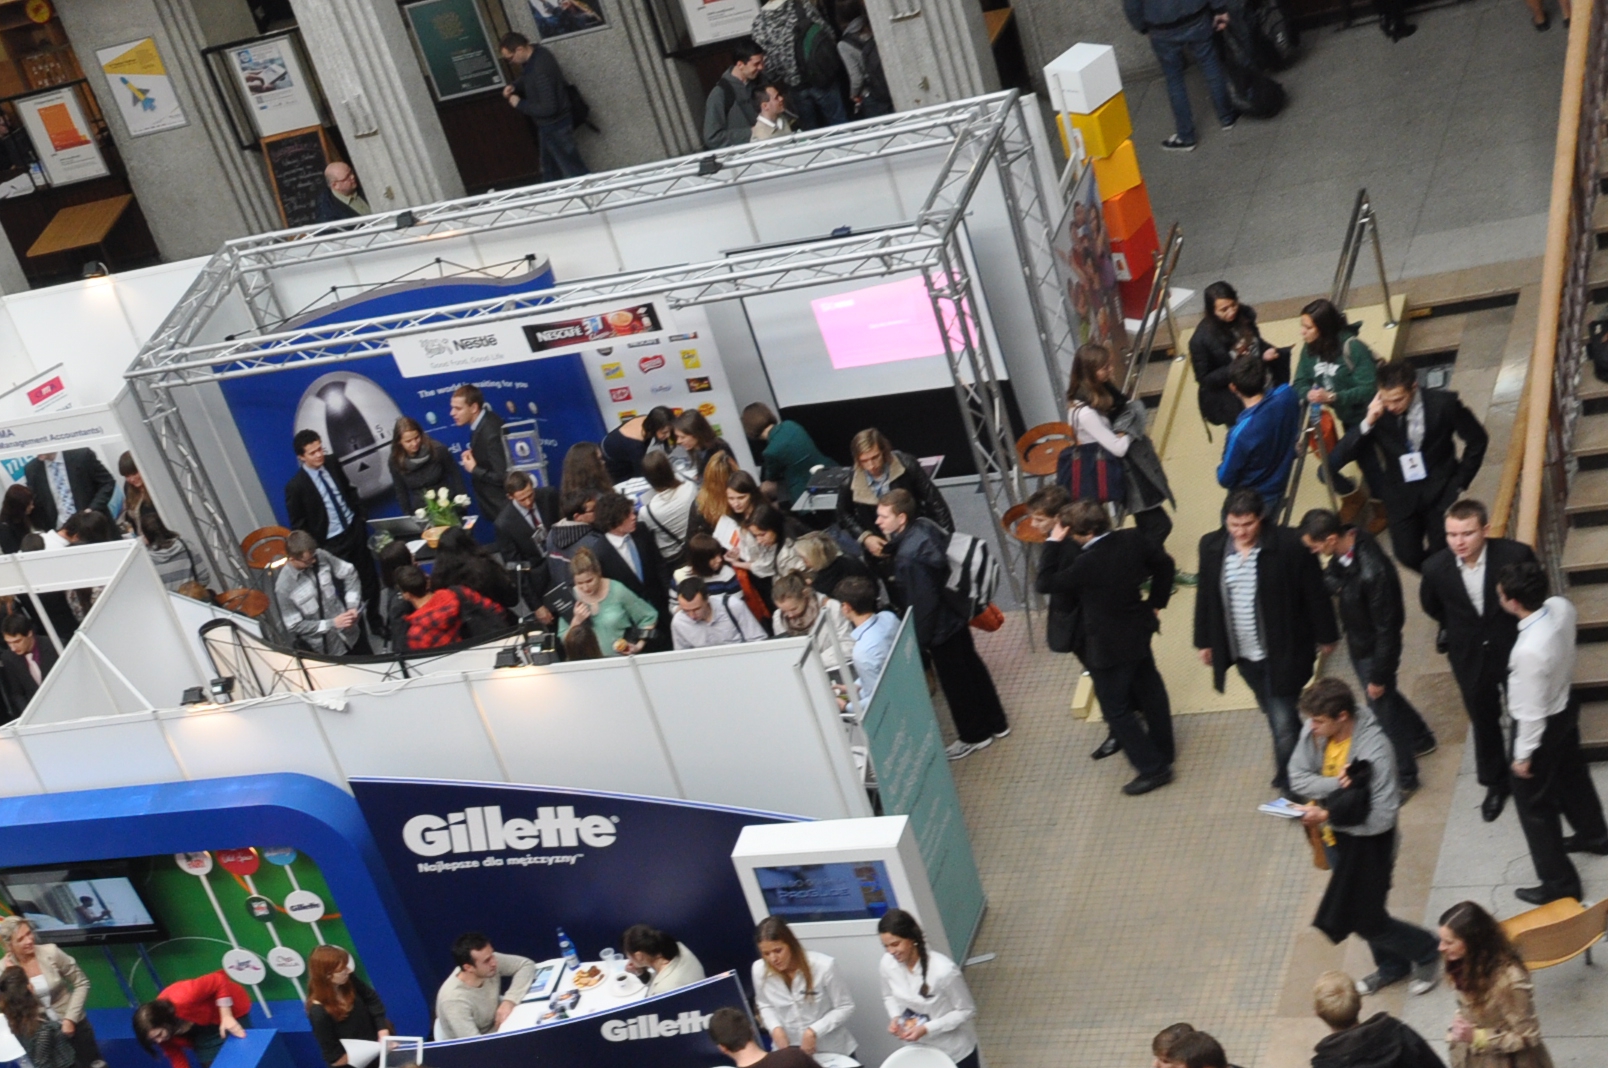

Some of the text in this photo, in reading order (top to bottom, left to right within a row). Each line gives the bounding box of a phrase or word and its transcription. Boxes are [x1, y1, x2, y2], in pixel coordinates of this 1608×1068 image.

[417, 389, 436, 399] The
[515, 381, 529, 389] you
[49, 426, 104, 442] Accountants)
[402, 806, 618, 857] Gillette
[417, 857, 480, 873] Najlepsze
[482, 855, 504, 867] dla
